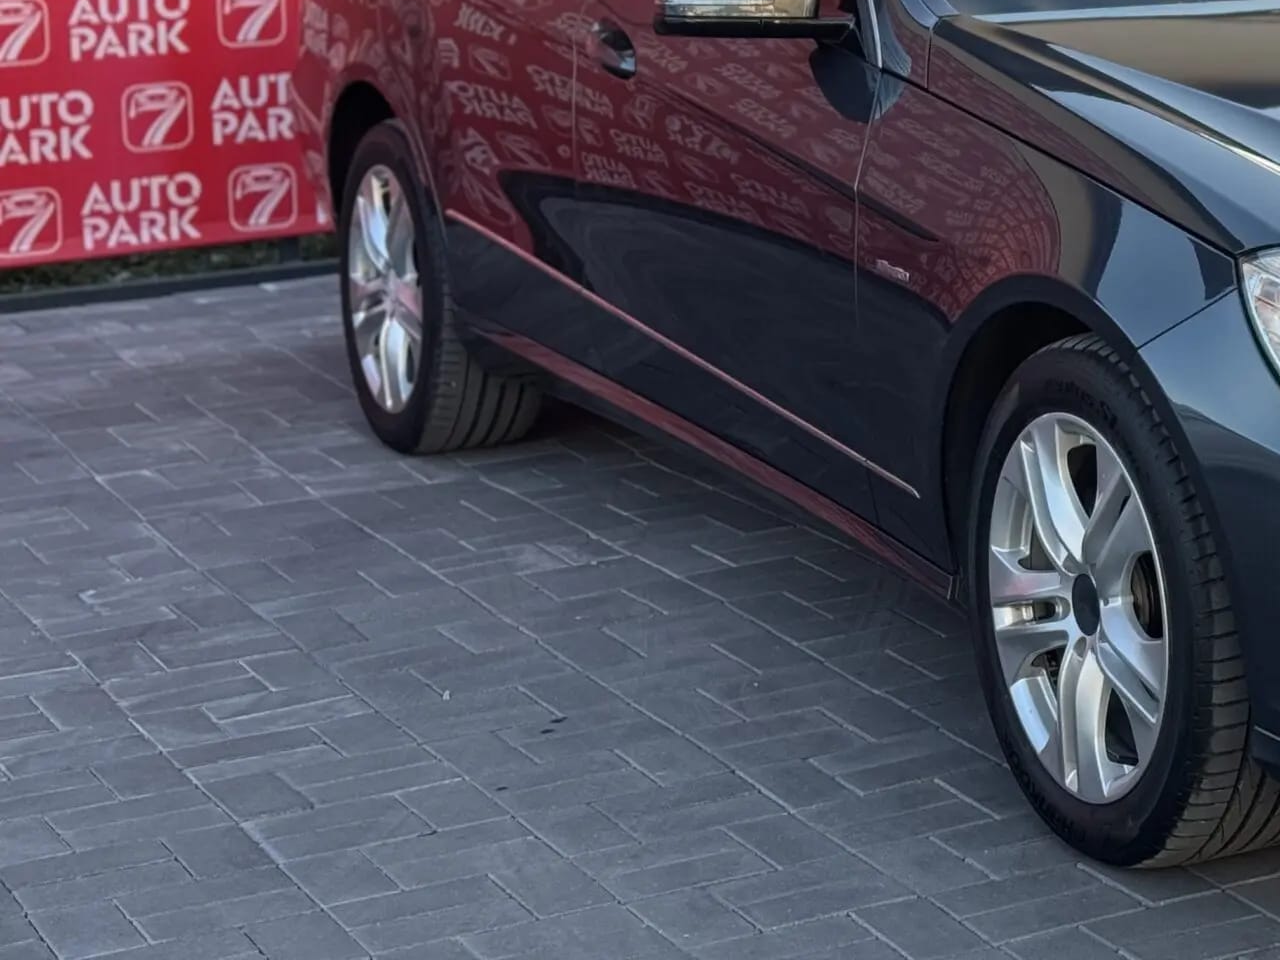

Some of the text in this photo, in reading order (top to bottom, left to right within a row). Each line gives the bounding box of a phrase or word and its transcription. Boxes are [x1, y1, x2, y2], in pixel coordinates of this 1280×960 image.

[70, 18, 189, 62] PARK
[0, 90, 94, 131] UTO
[211, 72, 291, 112] AUT
[0, 124, 93, 167] ARK
[212, 106, 294, 145] PAR
[81, 172, 202, 217] AUTO
[82, 206, 201, 252] PARK
